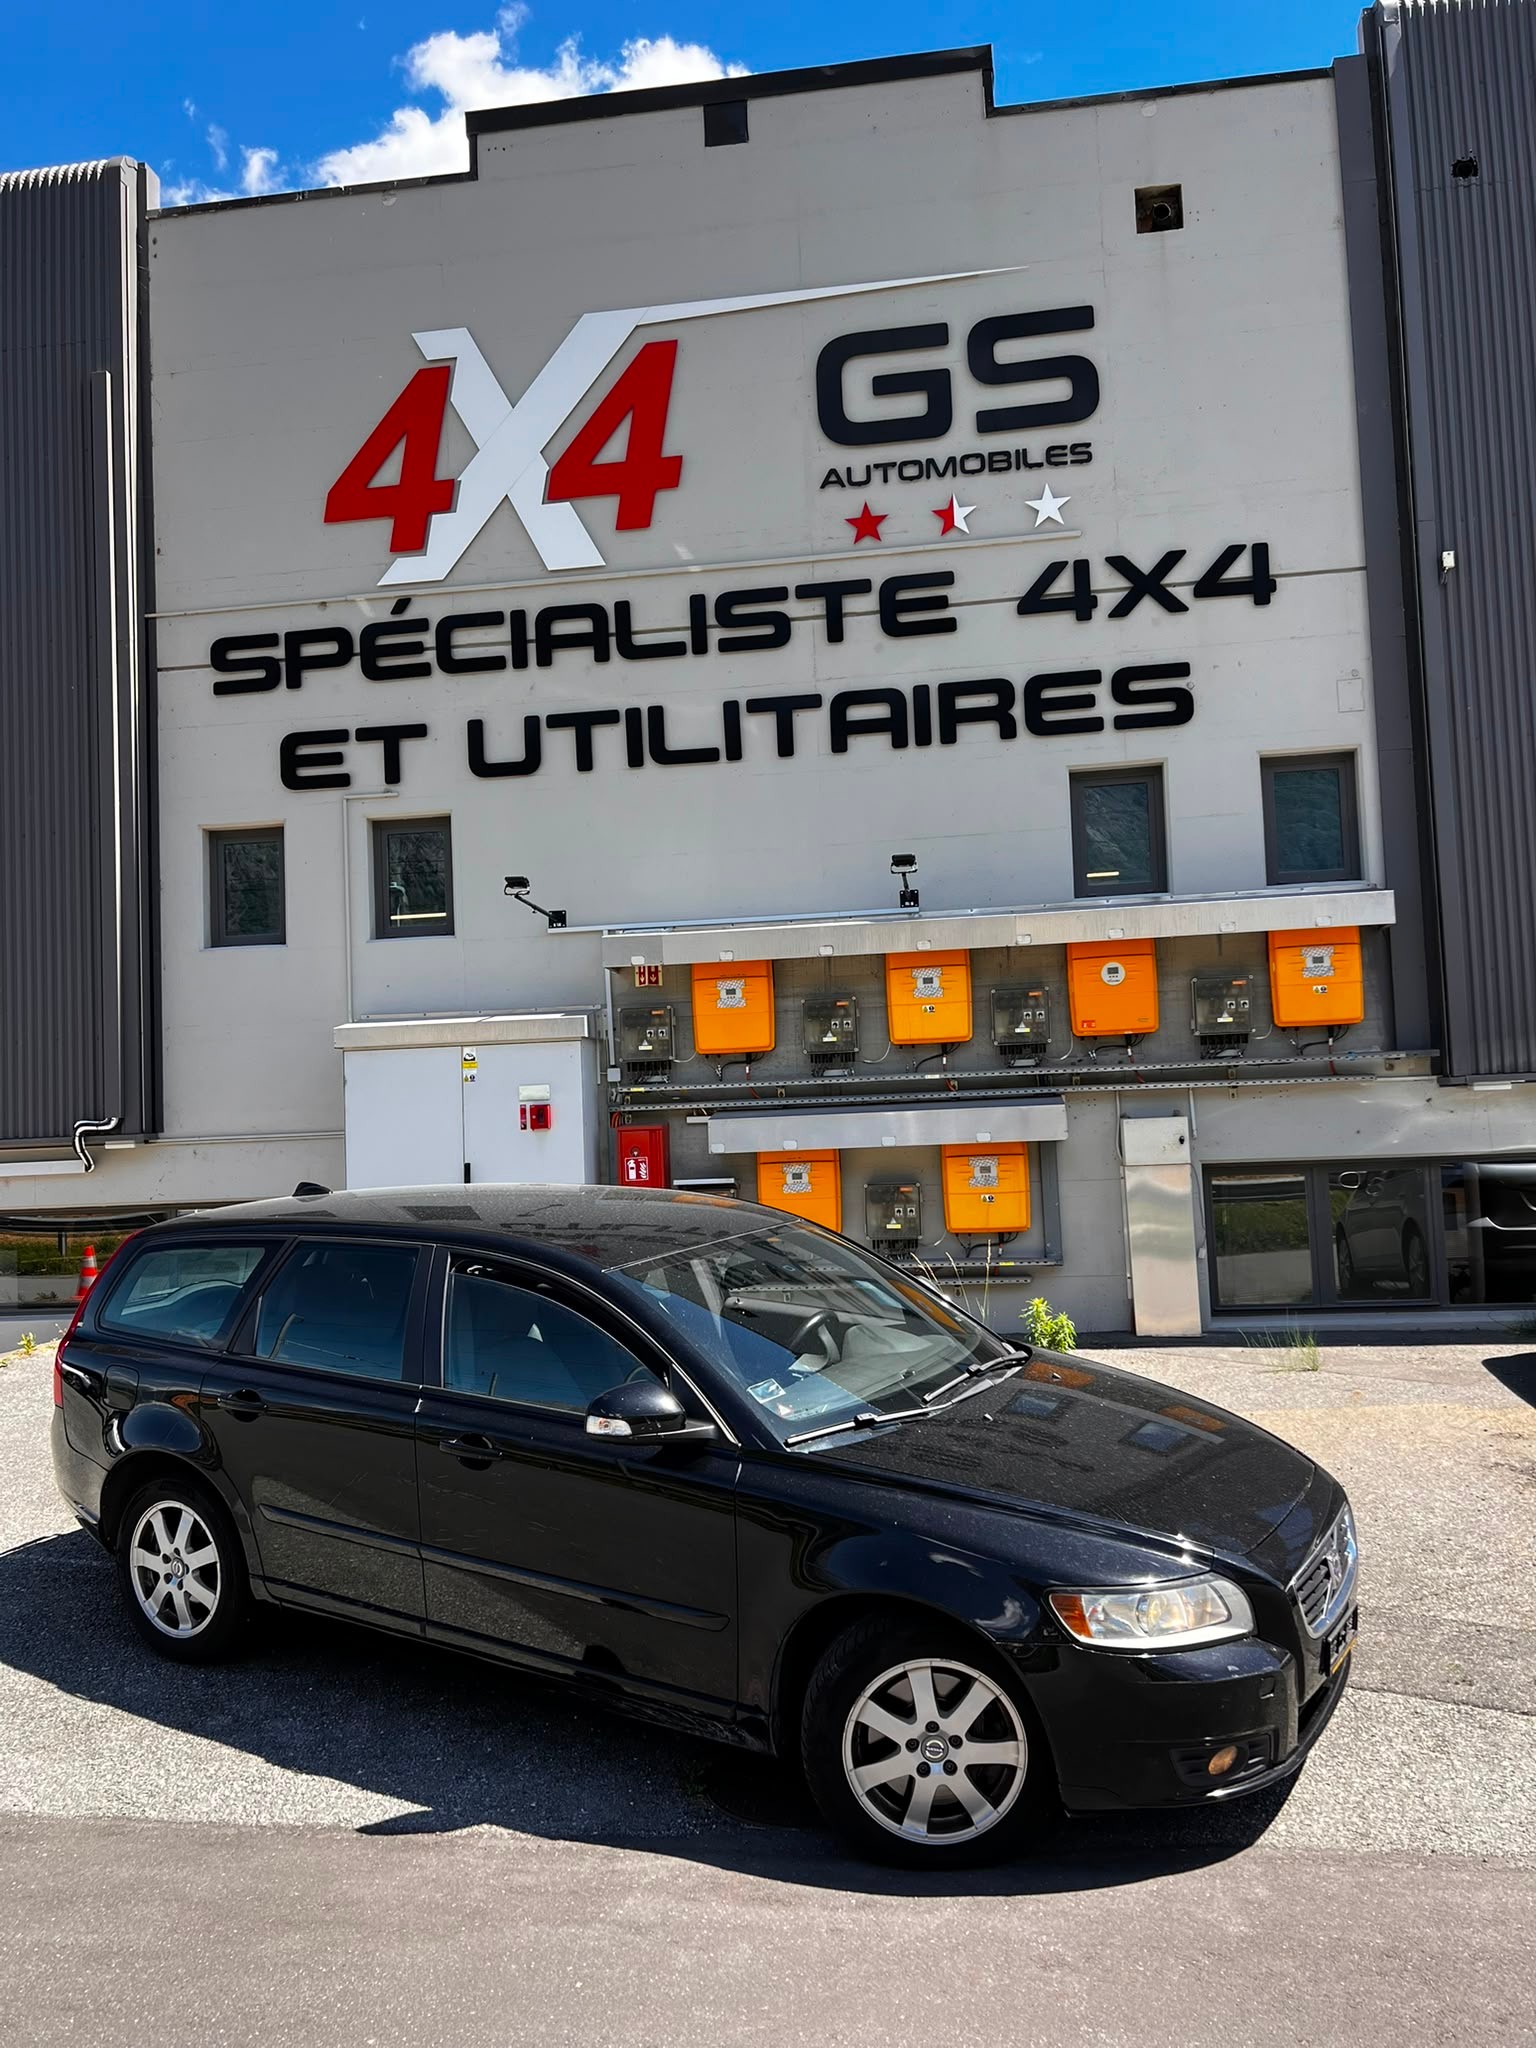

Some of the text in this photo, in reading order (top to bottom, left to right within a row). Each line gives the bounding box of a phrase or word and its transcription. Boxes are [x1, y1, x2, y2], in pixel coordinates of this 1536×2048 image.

[816, 304, 1101, 446] GS
[323, 308, 684, 586] 4X4
[819, 441, 1093, 490] AUTOMOBILES
[209, 541, 1278, 696] SPÉCIALISTE 4X4
[279, 661, 1195, 791] ET UTILITAIRES
